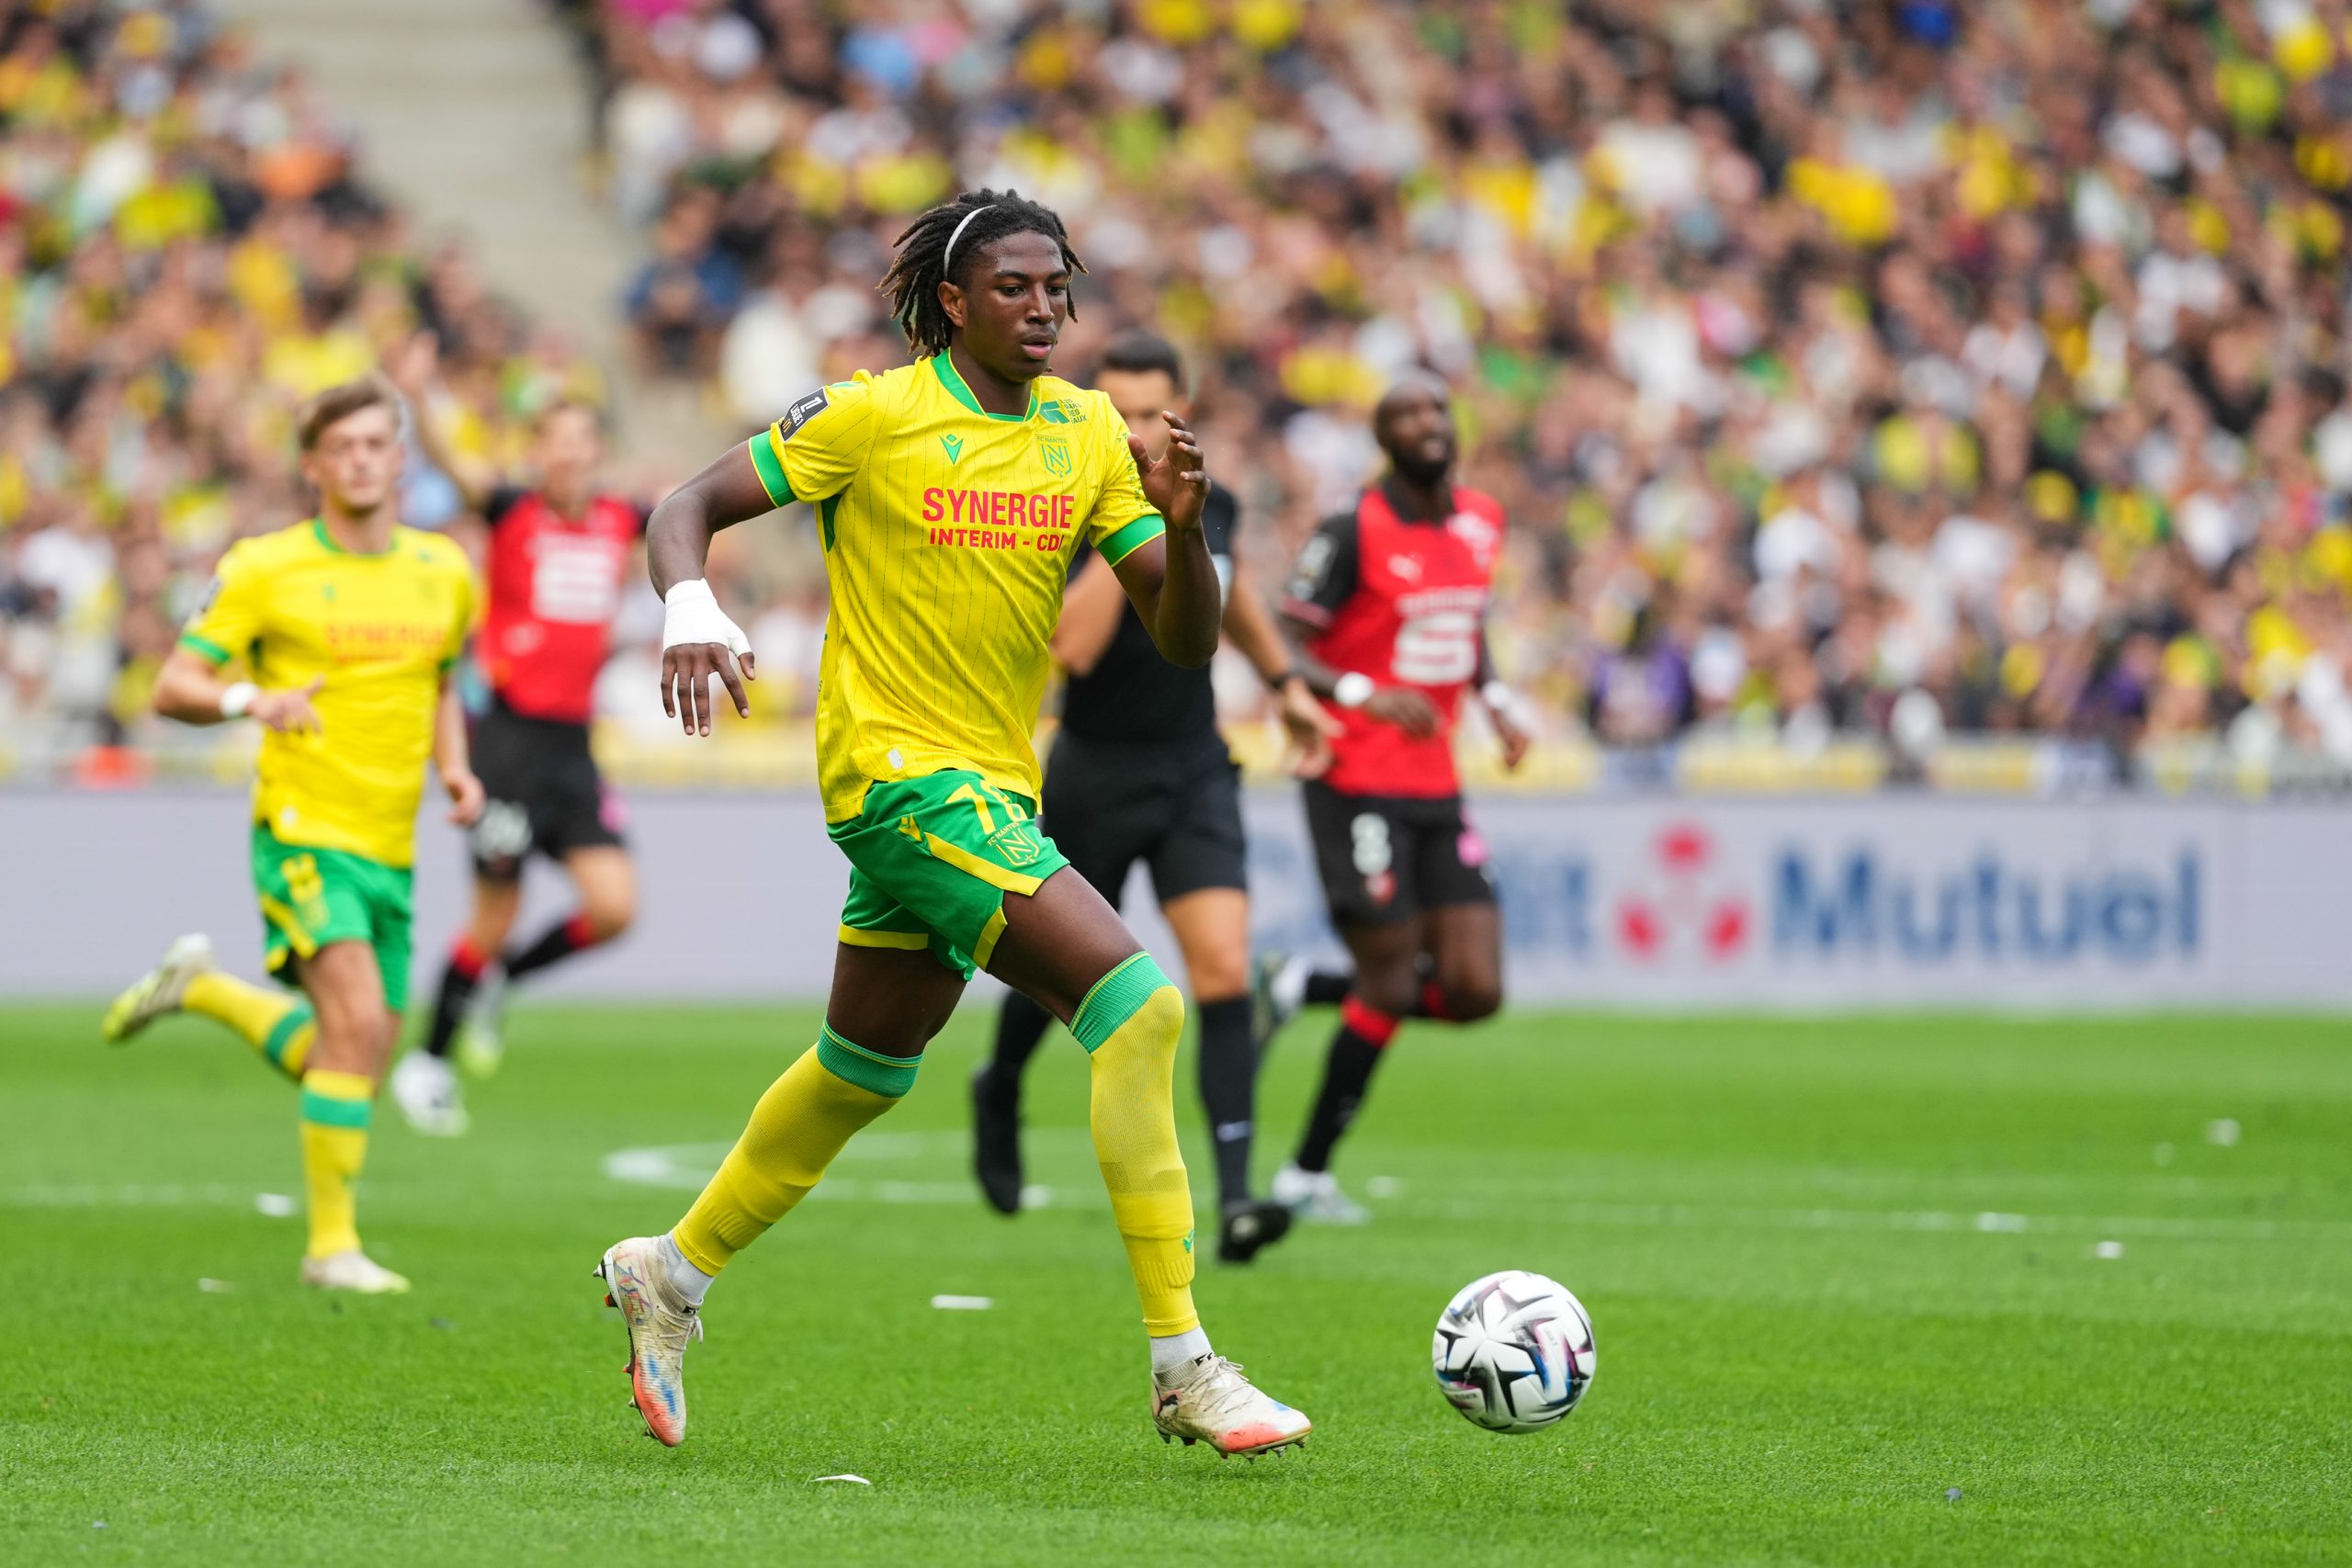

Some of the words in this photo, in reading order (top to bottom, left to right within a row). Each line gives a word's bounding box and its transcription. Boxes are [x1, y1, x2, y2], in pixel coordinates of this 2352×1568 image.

[922, 487, 1074, 529] SYNERGIE
[930, 528, 1016, 550] INTERIM
[987, 836, 997, 846] FC
[995, 821, 1020, 840] NANTES
[1773, 840, 2201, 963] Mutuel
